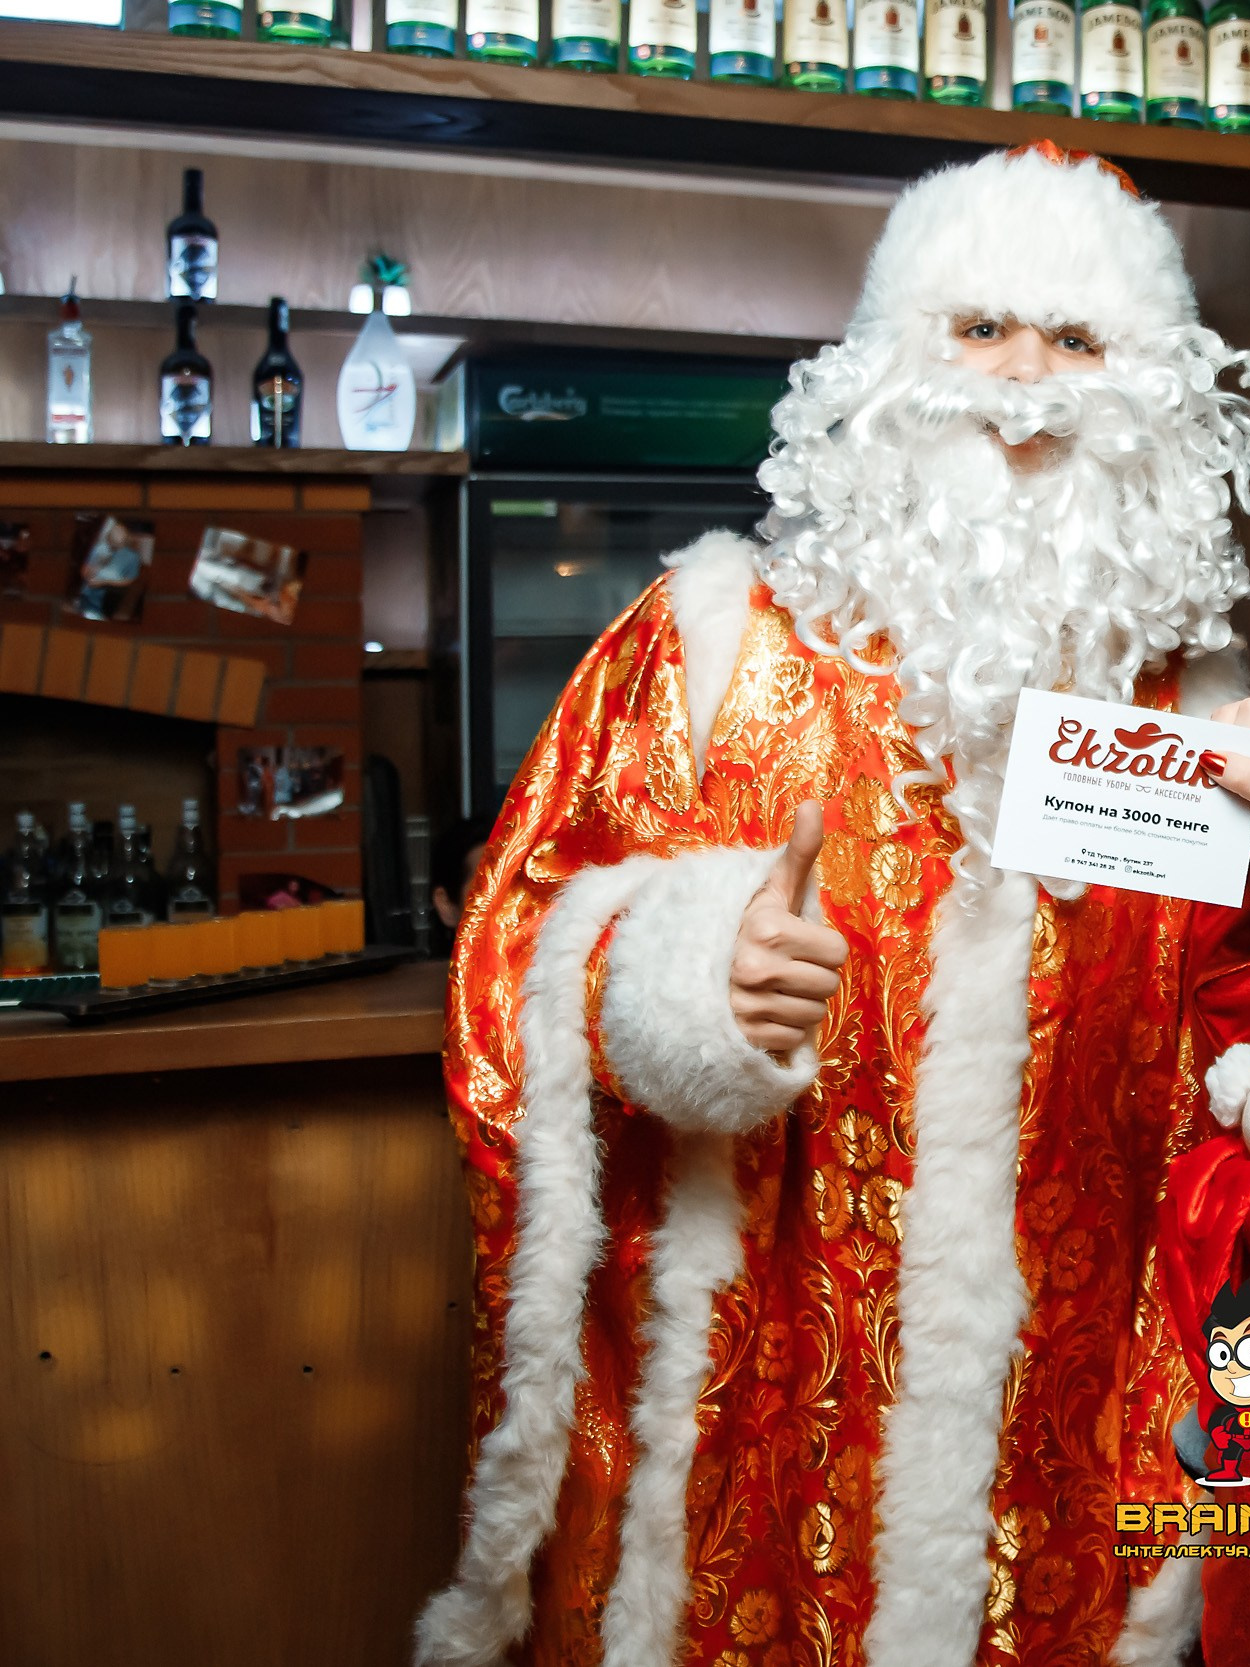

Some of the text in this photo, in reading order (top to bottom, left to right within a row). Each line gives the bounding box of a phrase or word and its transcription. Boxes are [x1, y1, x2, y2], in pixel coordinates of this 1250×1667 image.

[1063, 771, 1202, 803] ГОЛОВНЫЕ УБОРЫ АКСЕССУАРЫ
[1044, 795, 1210, 834] Купон на 3000 тенге
[1059, 817, 1079, 827] право
[1079, 821, 1103, 830] оплаты
[1113, 825, 1133, 835] более
[1133, 828, 1147, 837] 50%
[1147, 831, 1181, 842] стоимости
[1181, 837, 1208, 847] покупки
